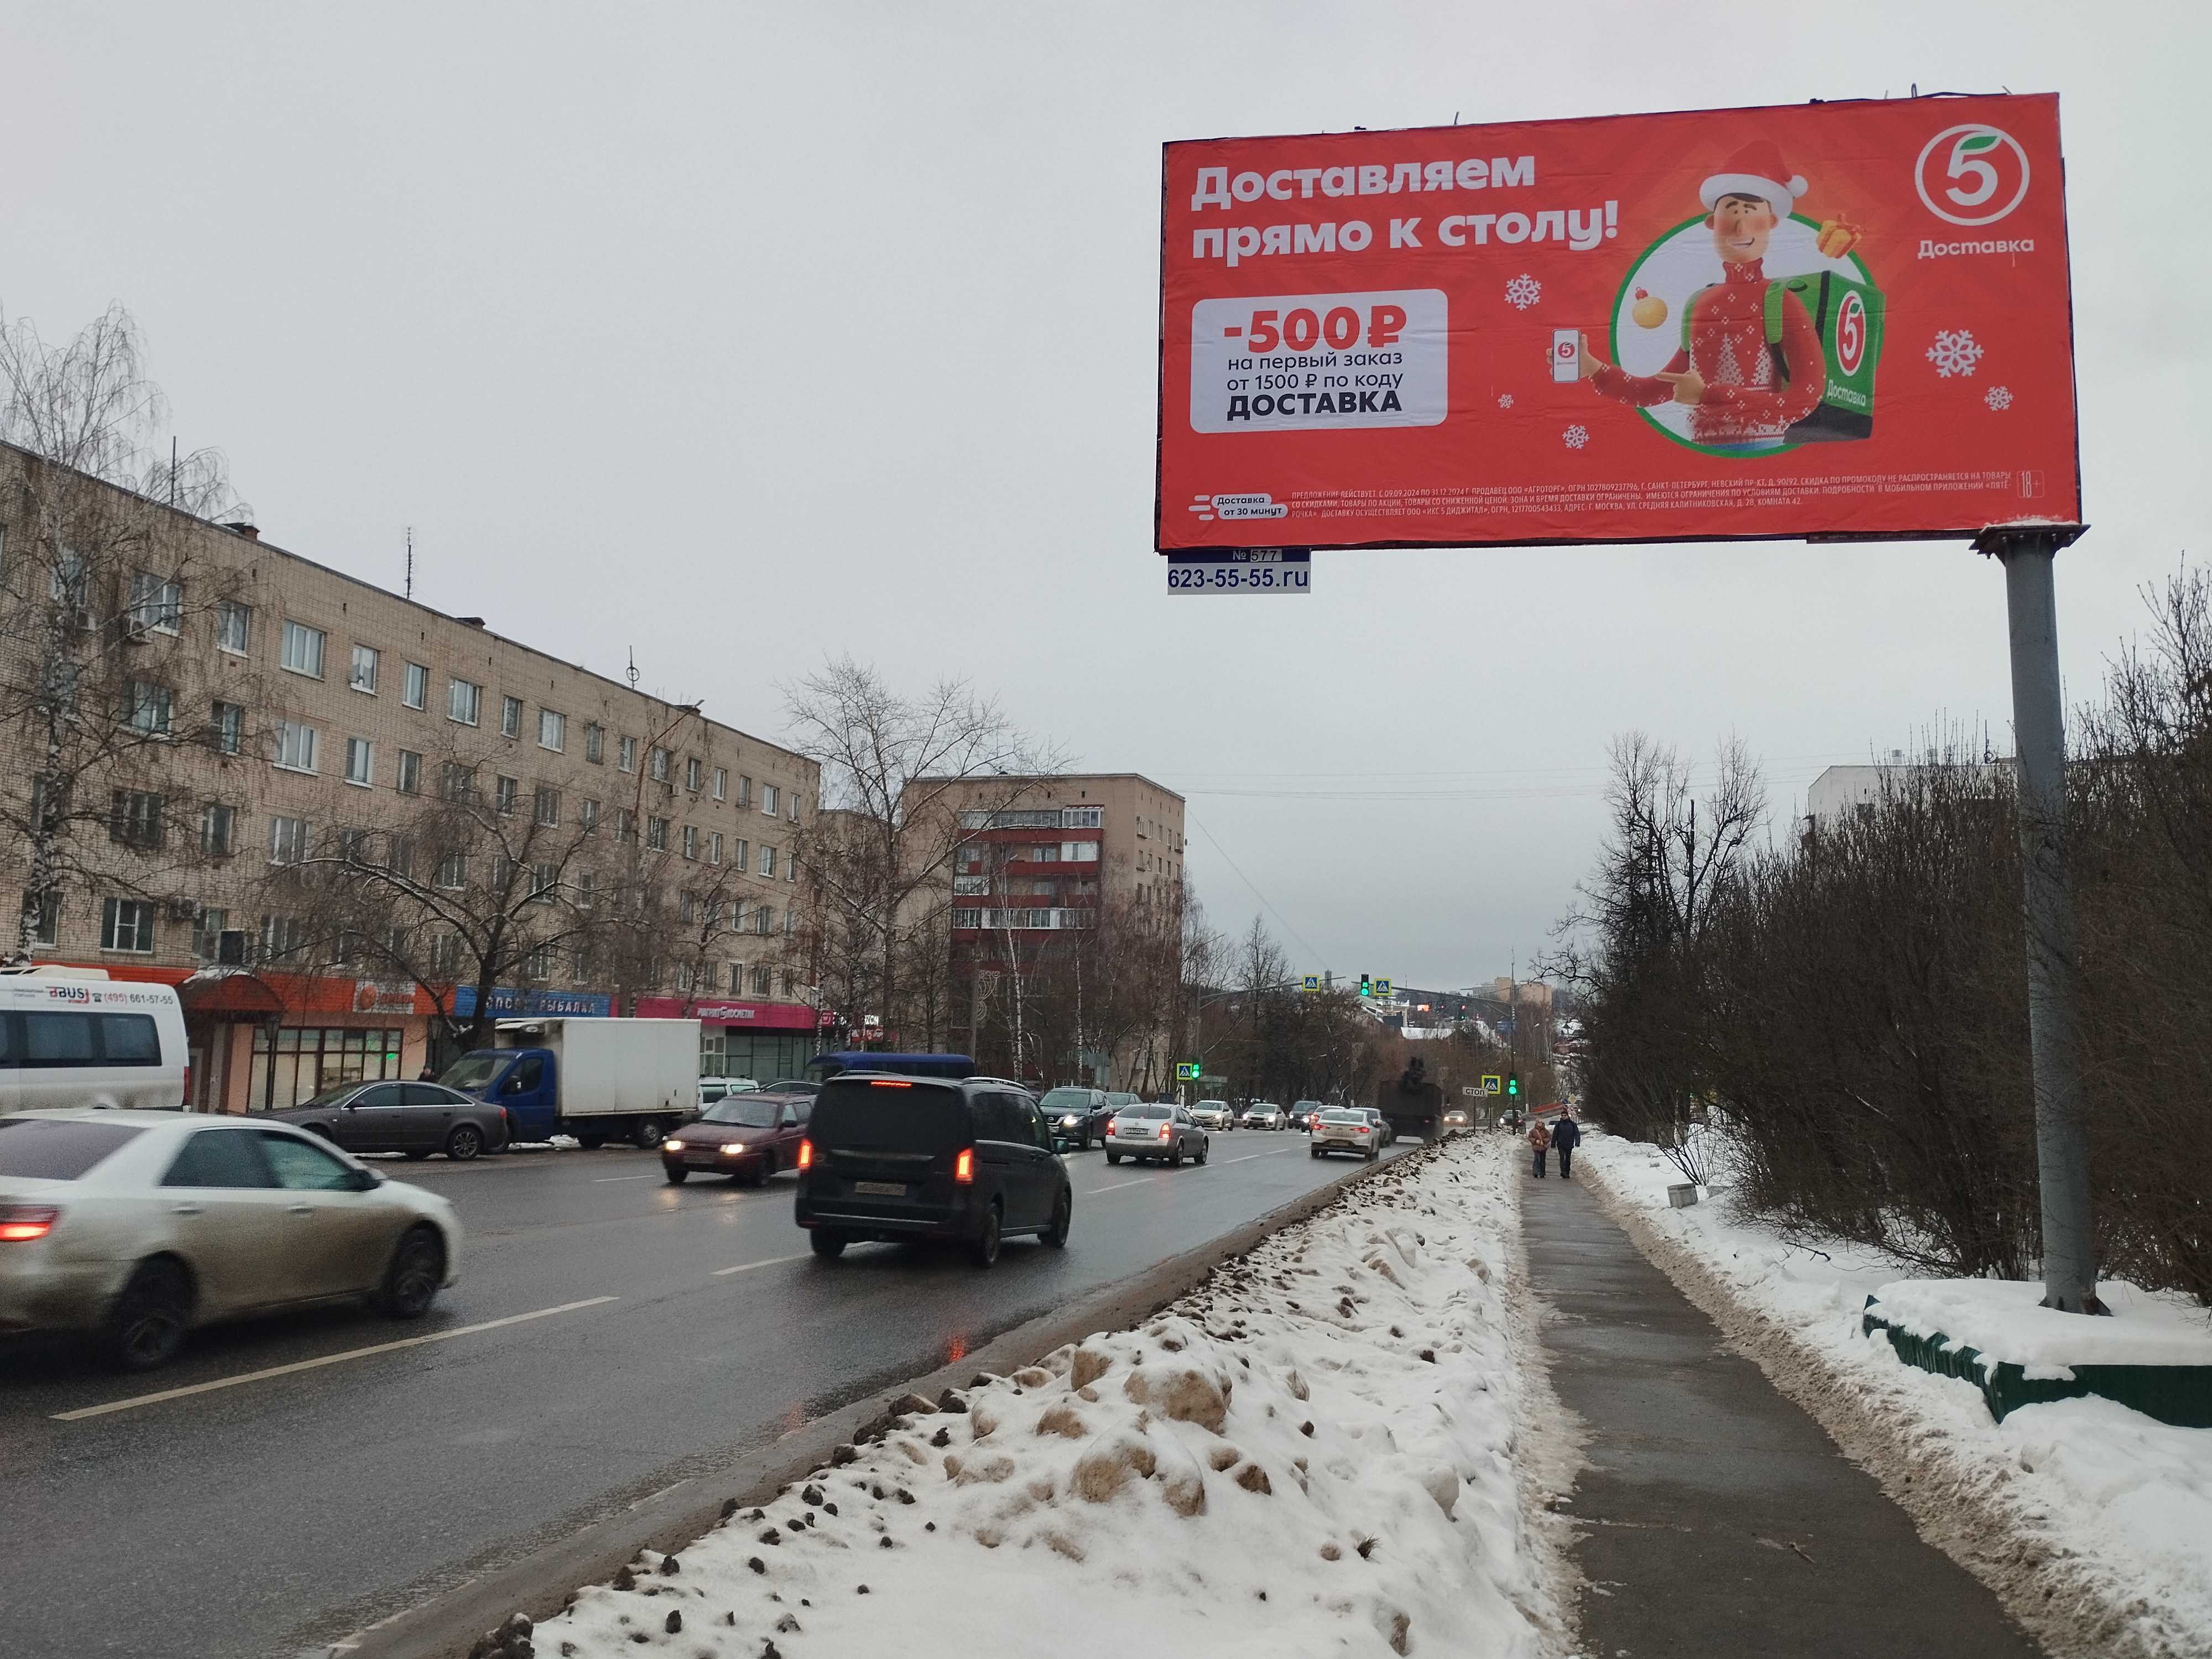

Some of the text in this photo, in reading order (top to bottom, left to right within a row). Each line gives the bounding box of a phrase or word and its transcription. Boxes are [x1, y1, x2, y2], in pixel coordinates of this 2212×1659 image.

[1191, 155, 1535, 211] Доставляем
[1192, 200, 1618, 267] прямо к столу!
[1917, 236, 2034, 259] Доставка
[1228, 352, 1402, 372] на первый заказ
[1227, 379, 1249, 390] от
[1255, 374, 1298, 390] 1500
[1324, 375, 1348, 388] по
[1355, 373, 1404, 389] коду
[1827, 379, 1866, 406] Доставка
[1227, 390, 1402, 421] ДОСТАВКА
[1292, 491, 1339, 500] ПРЕДЛОЖЕНИЕ
[1340, 489, 1376, 499] ДЕЙСТВУЕТ
[1472, 487, 1507, 496] ПРОДАВЕЦ
[1508, 486, 1522, 494] ООО
[1647, 480, 1710, 489] САНКТ-ПЕТЕРБУРГ,
[1712, 478, 1743, 488] НЕВСКИЙ
[1801, 477, 1829, 487] СКИДКА
[1841, 474, 1887, 484] ПРОМОКОДУ
[1898, 472, 1969, 482] РАСПРОСТРАНЯЕТСЯ
[1982, 471, 2011, 479] ТОВАРЫ
[1302, 500, 1340, 509] СКИДКАМИ,
[1341, 499, 1366, 508] ТОВАРЫ
[1379, 499, 1403, 508] АКЦИИ,
[1442, 496, 1483, 505] СНИЖЕННОЙ
[1560, 493, 1595, 503] ДОСТАВКИ
[1646, 491, 1679, 500] ИМЕЮТСЯ
[1681, 490, 1730, 498] ОГРАНИЧЕНИЯ
[1743, 488, 1781, 497] УСЛОВИЯМ
[1822, 484, 1875, 495] ПОДРОБНОСТИ
[1878, 484, 1883, 493] В
[1885, 483, 1931, 493] МОБИЛЬНОМ
[1933, 482, 1984, 491] ПРИЛОЖЕНИИ
[1217, 497, 1265, 505] Доставка
[1321, 509, 1354, 518] ДОСТАВКУ
[1355, 508, 1405, 518] ОСУЩЕСТВЛЯЕТ
[1639, 500, 1670, 510] СРЕДНЯЯ
[1671, 499, 1735, 508] КАЛИТНИКОВСКАЯ,
[1757, 497, 1791, 506] КОМНАТА
[1250, 508, 1282, 516] минут
[1233, 550, 1277, 561] № 577
[1168, 568, 1308, 588] 623-55-55.ru
[486, 996, 528, 1010] СПО
